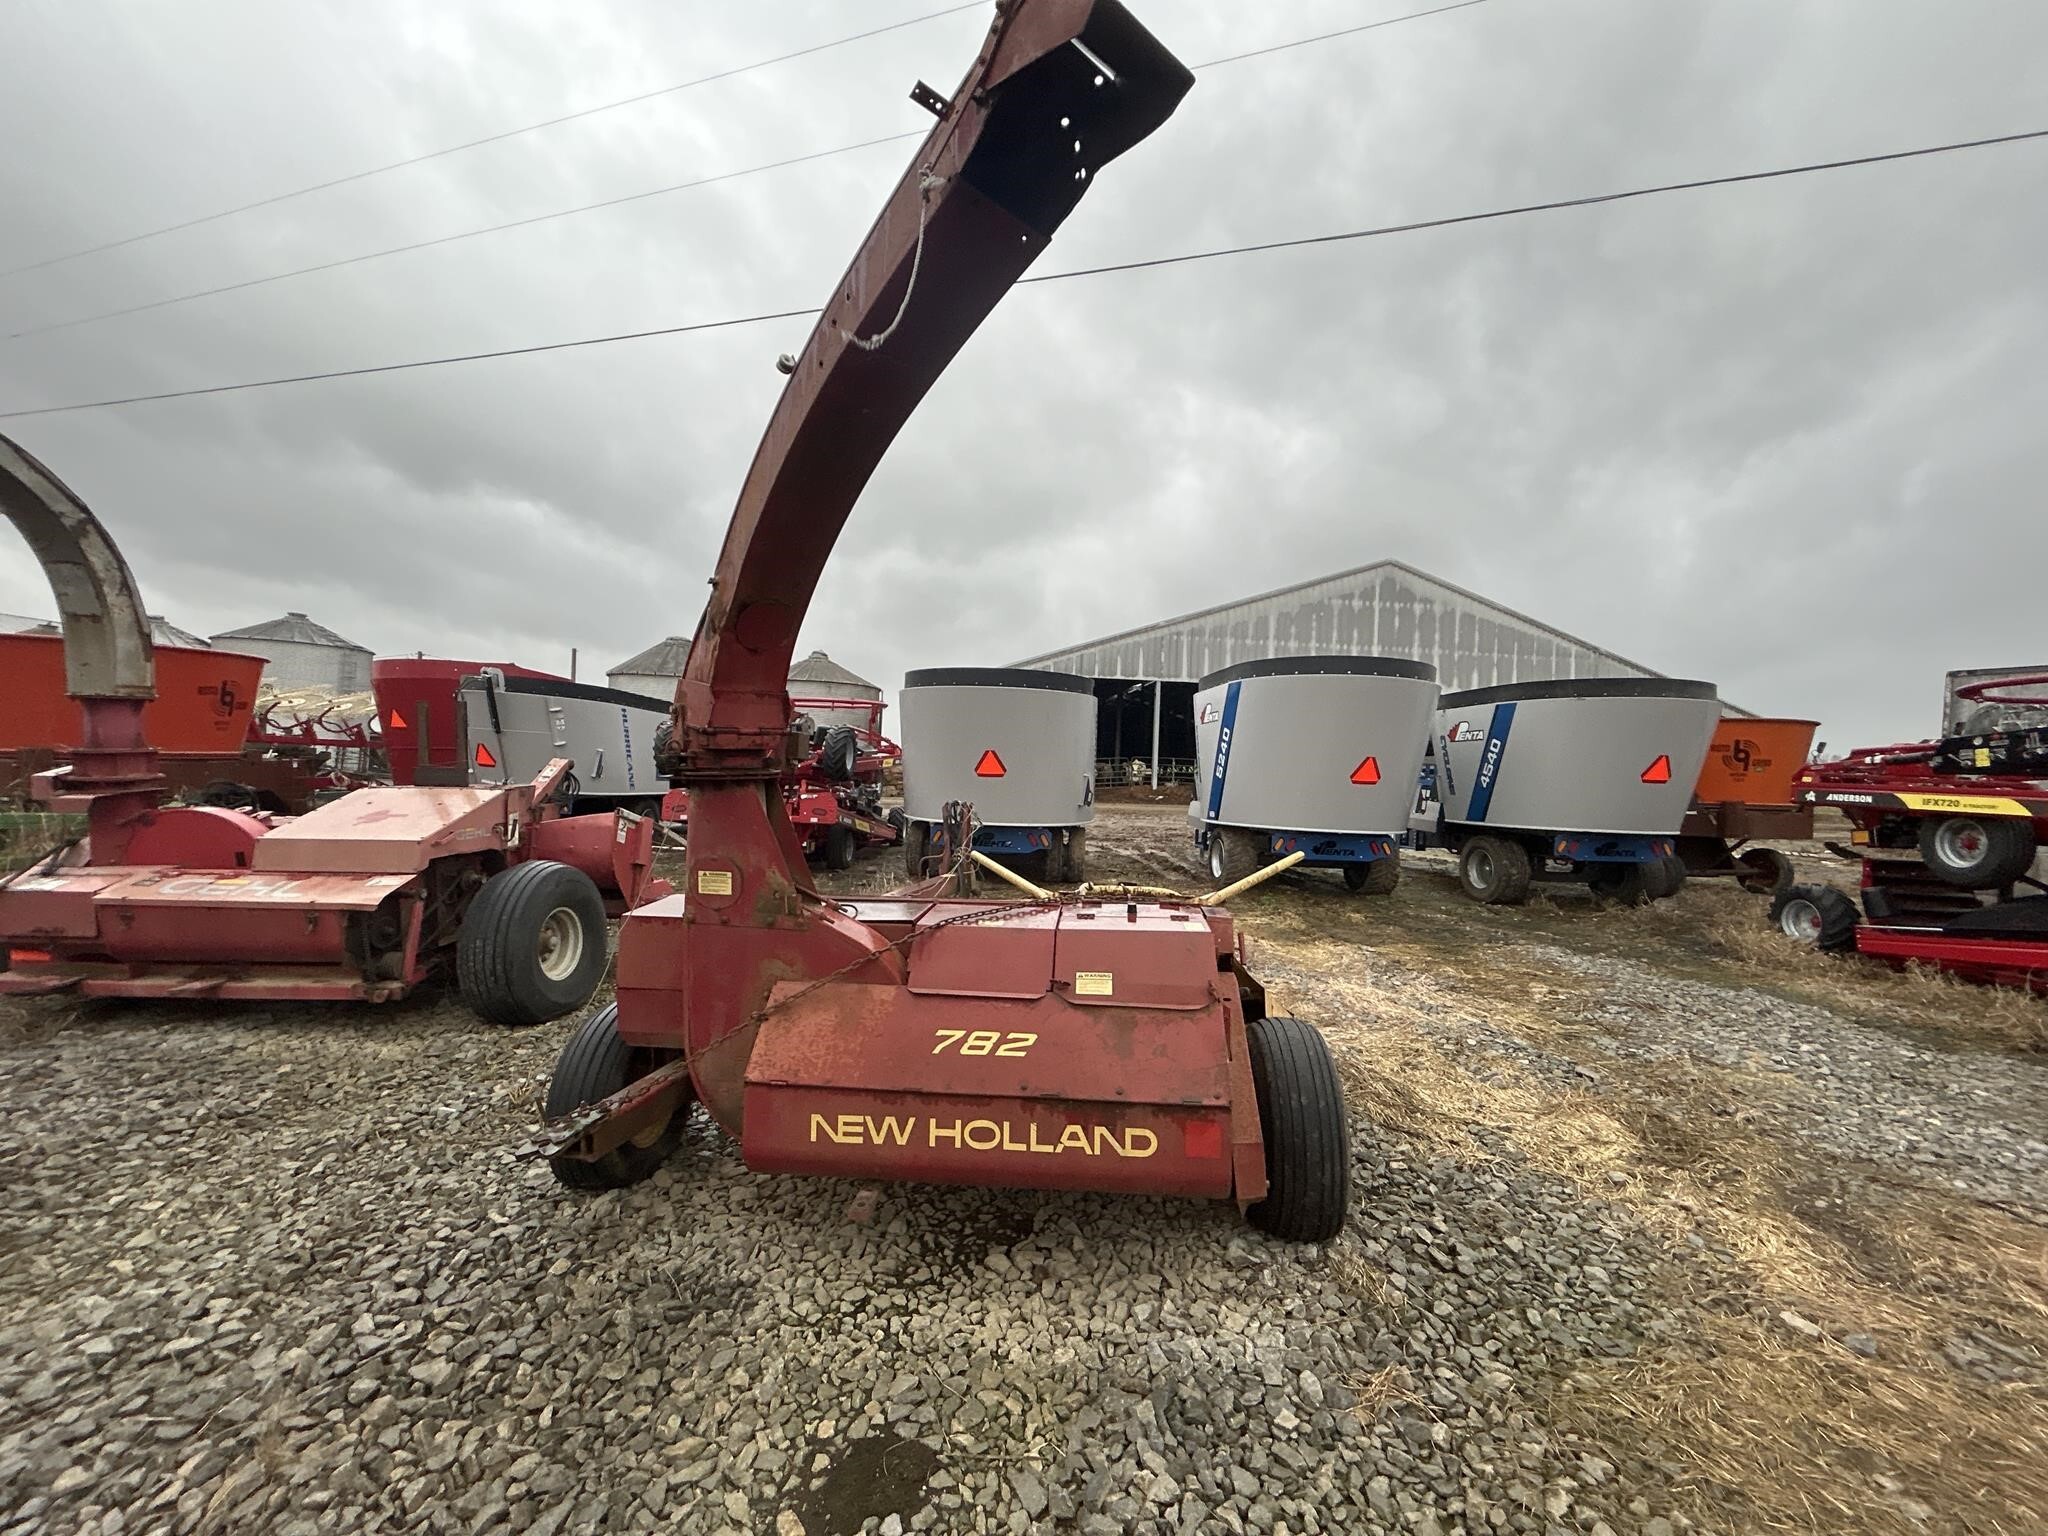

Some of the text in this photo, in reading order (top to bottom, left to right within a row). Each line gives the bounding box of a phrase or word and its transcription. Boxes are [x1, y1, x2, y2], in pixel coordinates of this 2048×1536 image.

[1450, 721, 1484, 742] PENTA
[621, 707, 636, 791] HURRICANE
[1216, 727, 1230, 779] 5240
[1480, 738, 1501, 788] 4540
[1826, 794, 1873, 803] ANDERSON
[1922, 798, 1960, 808] IFX720
[456, 827, 492, 840] GEHL
[931, 1029, 1038, 1057] 782
[810, 1113, 1158, 1158] NEW HOLLAND
